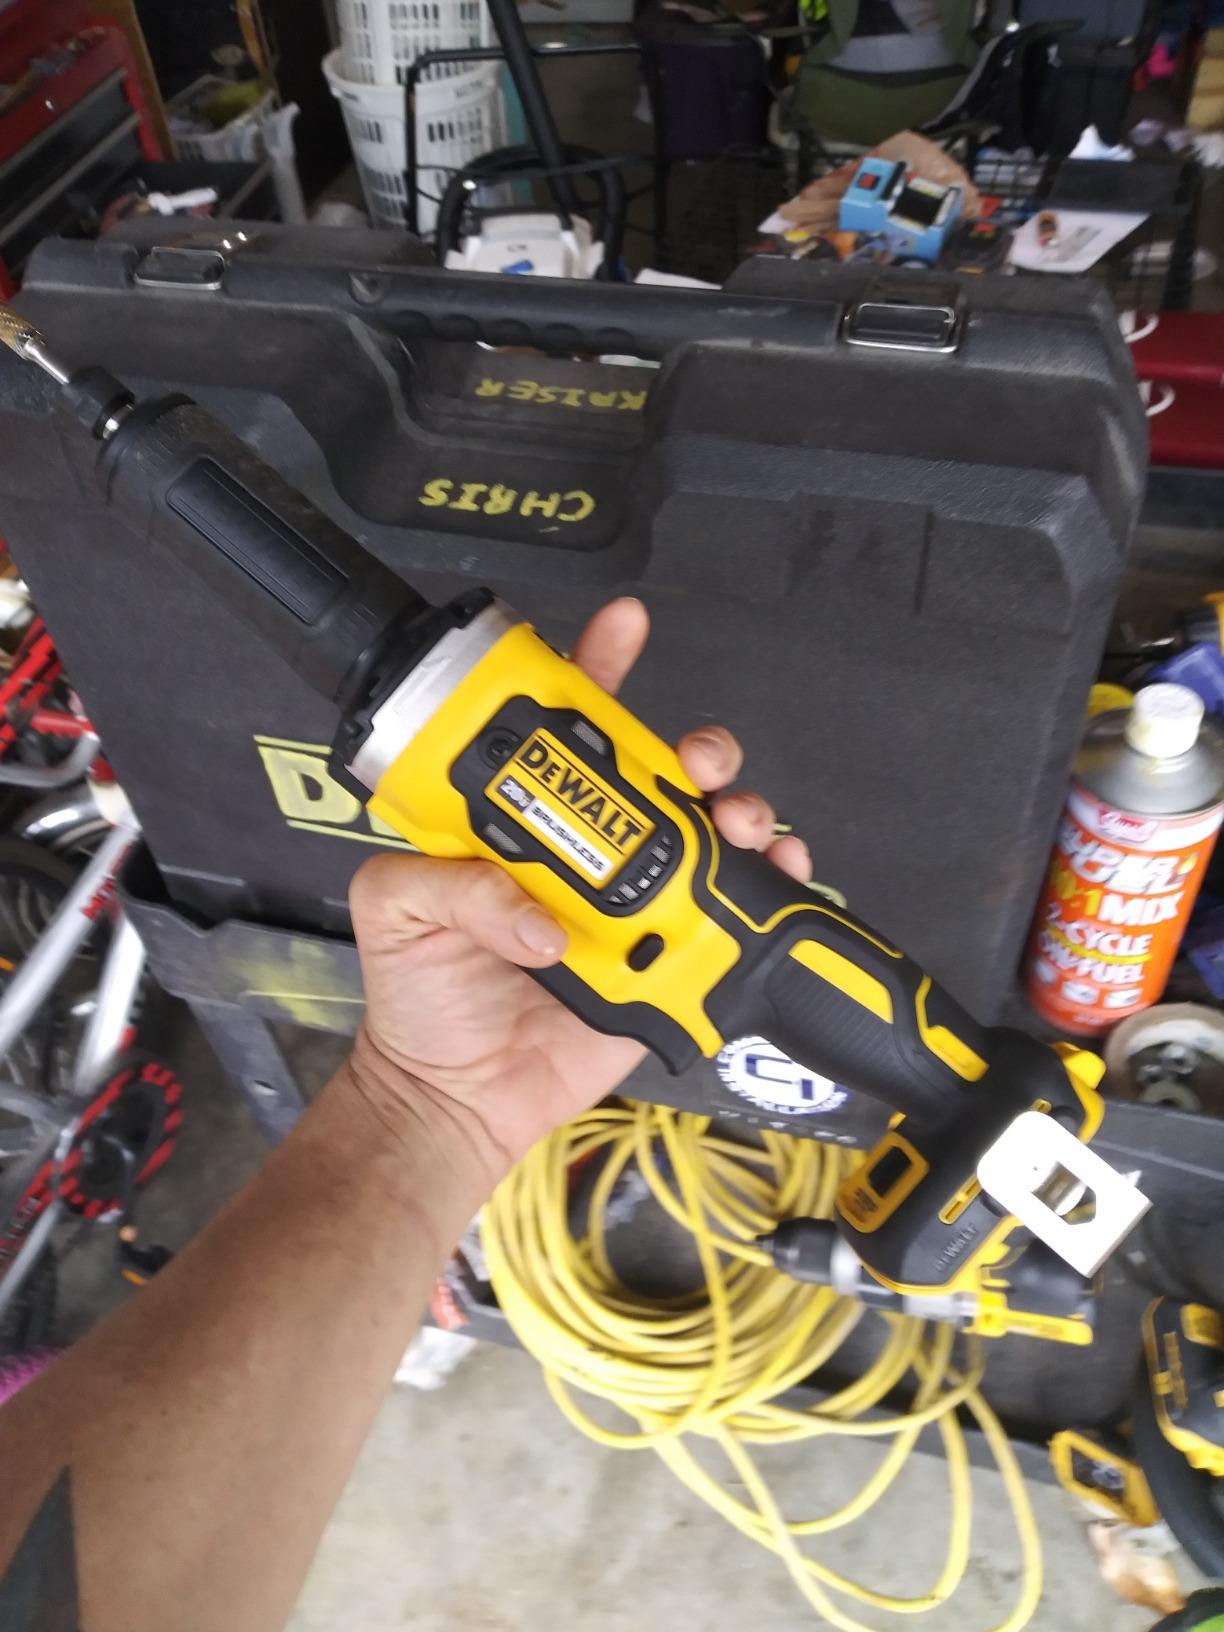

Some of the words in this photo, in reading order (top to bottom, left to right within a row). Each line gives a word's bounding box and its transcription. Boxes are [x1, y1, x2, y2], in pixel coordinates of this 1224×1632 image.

[475, 378, 647, 410] KAISER
[418, 478, 596, 522] CHRIS
[1097, 889, 1185, 927] MIX
